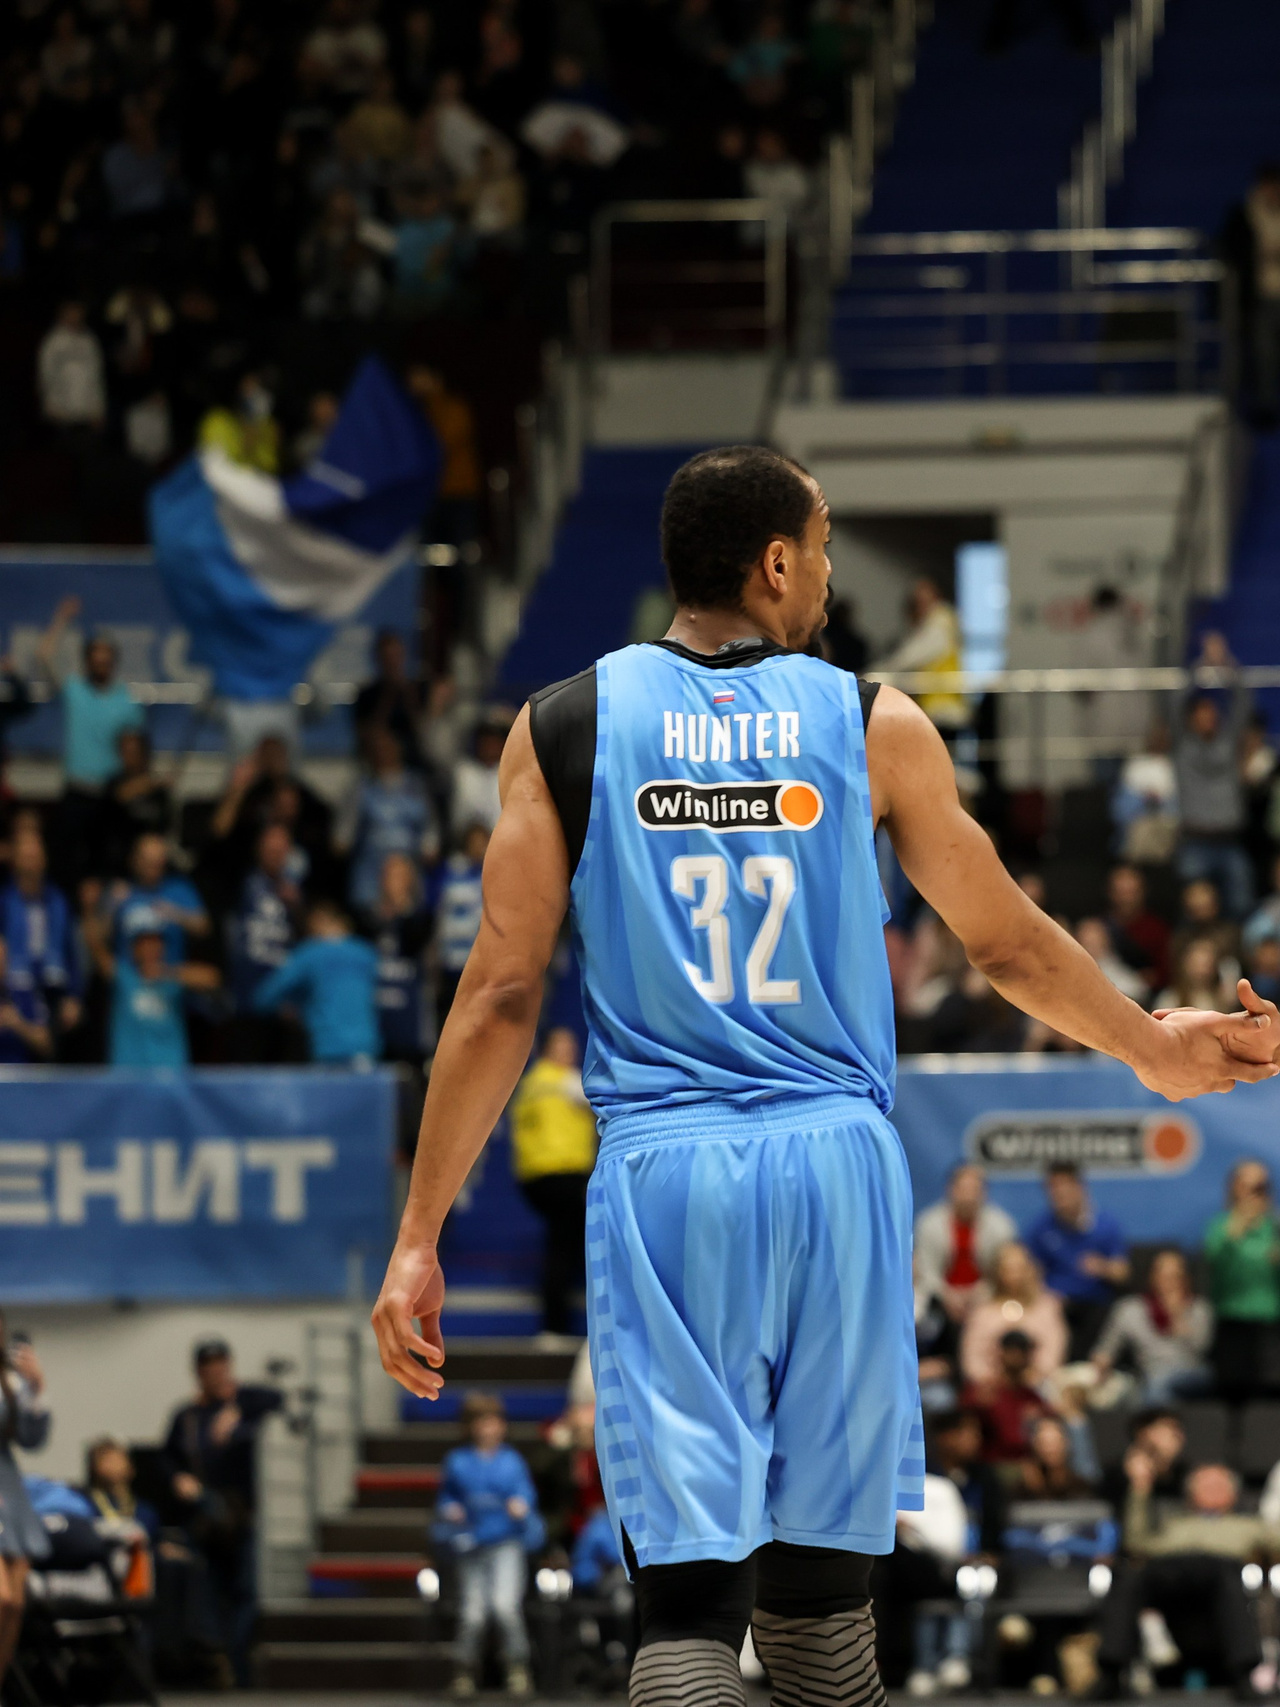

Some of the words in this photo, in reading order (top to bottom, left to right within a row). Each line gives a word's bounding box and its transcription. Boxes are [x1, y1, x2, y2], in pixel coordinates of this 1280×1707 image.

[663, 711, 800, 762] HUNTER
[649, 791, 769, 822] Winline
[671, 854, 802, 1005] 32
